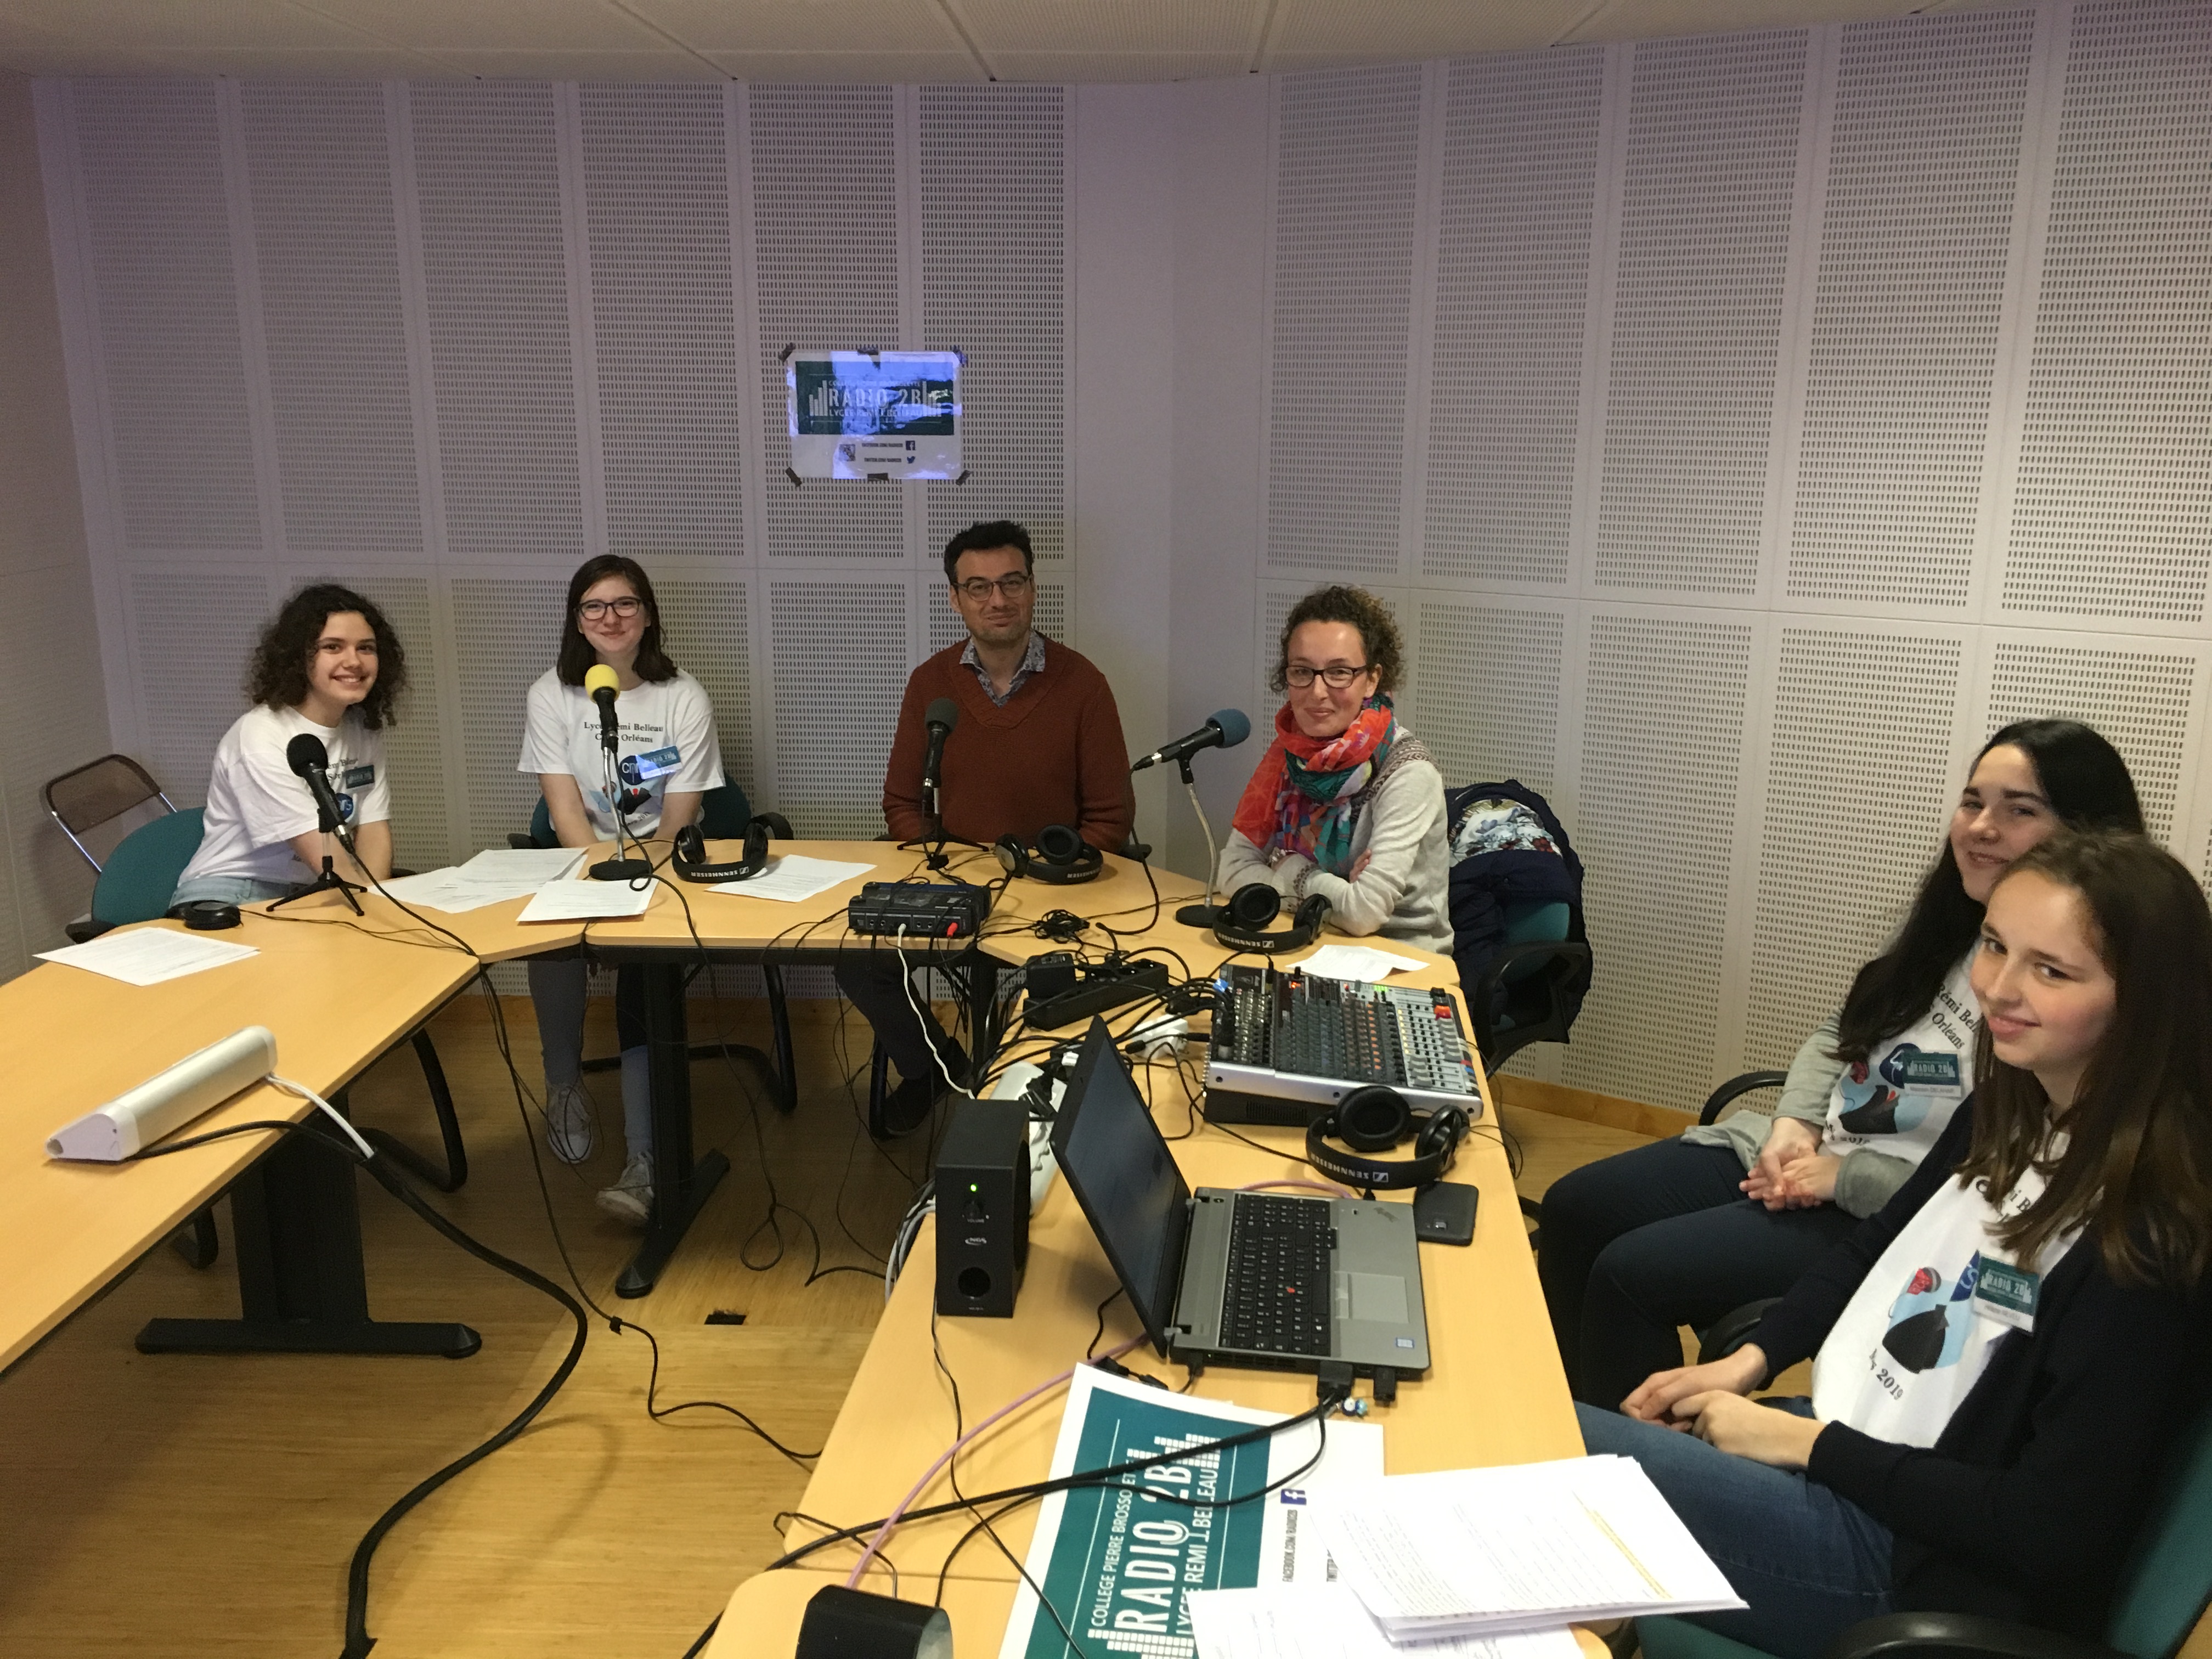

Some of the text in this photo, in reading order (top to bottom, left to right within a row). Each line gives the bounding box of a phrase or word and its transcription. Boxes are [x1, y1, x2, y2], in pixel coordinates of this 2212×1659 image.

[829, 388, 921, 408] RADIO 2B
[584, 721, 602, 731] Lyc
[634, 723, 663, 732] Belleau
[621, 734, 653, 743] Orléans
[1932, 1012, 1965, 1049] Orléans
[1959, 1008, 1977, 1033] Bell
[1914, 1063, 1936, 1073] RADIO
[1311, 1153, 1370, 1180] SENNHEISER
[1876, 1368, 1904, 1401] 2019
[1192, 1468, 1218, 1528] BELEAU
[1114, 1521, 1185, 1633] RADIO
[1183, 1544, 1208, 1583] REMI
[1091, 1574, 1115, 1627] COLLEGE
[1103, 1534, 1124, 1572] PIERRE
